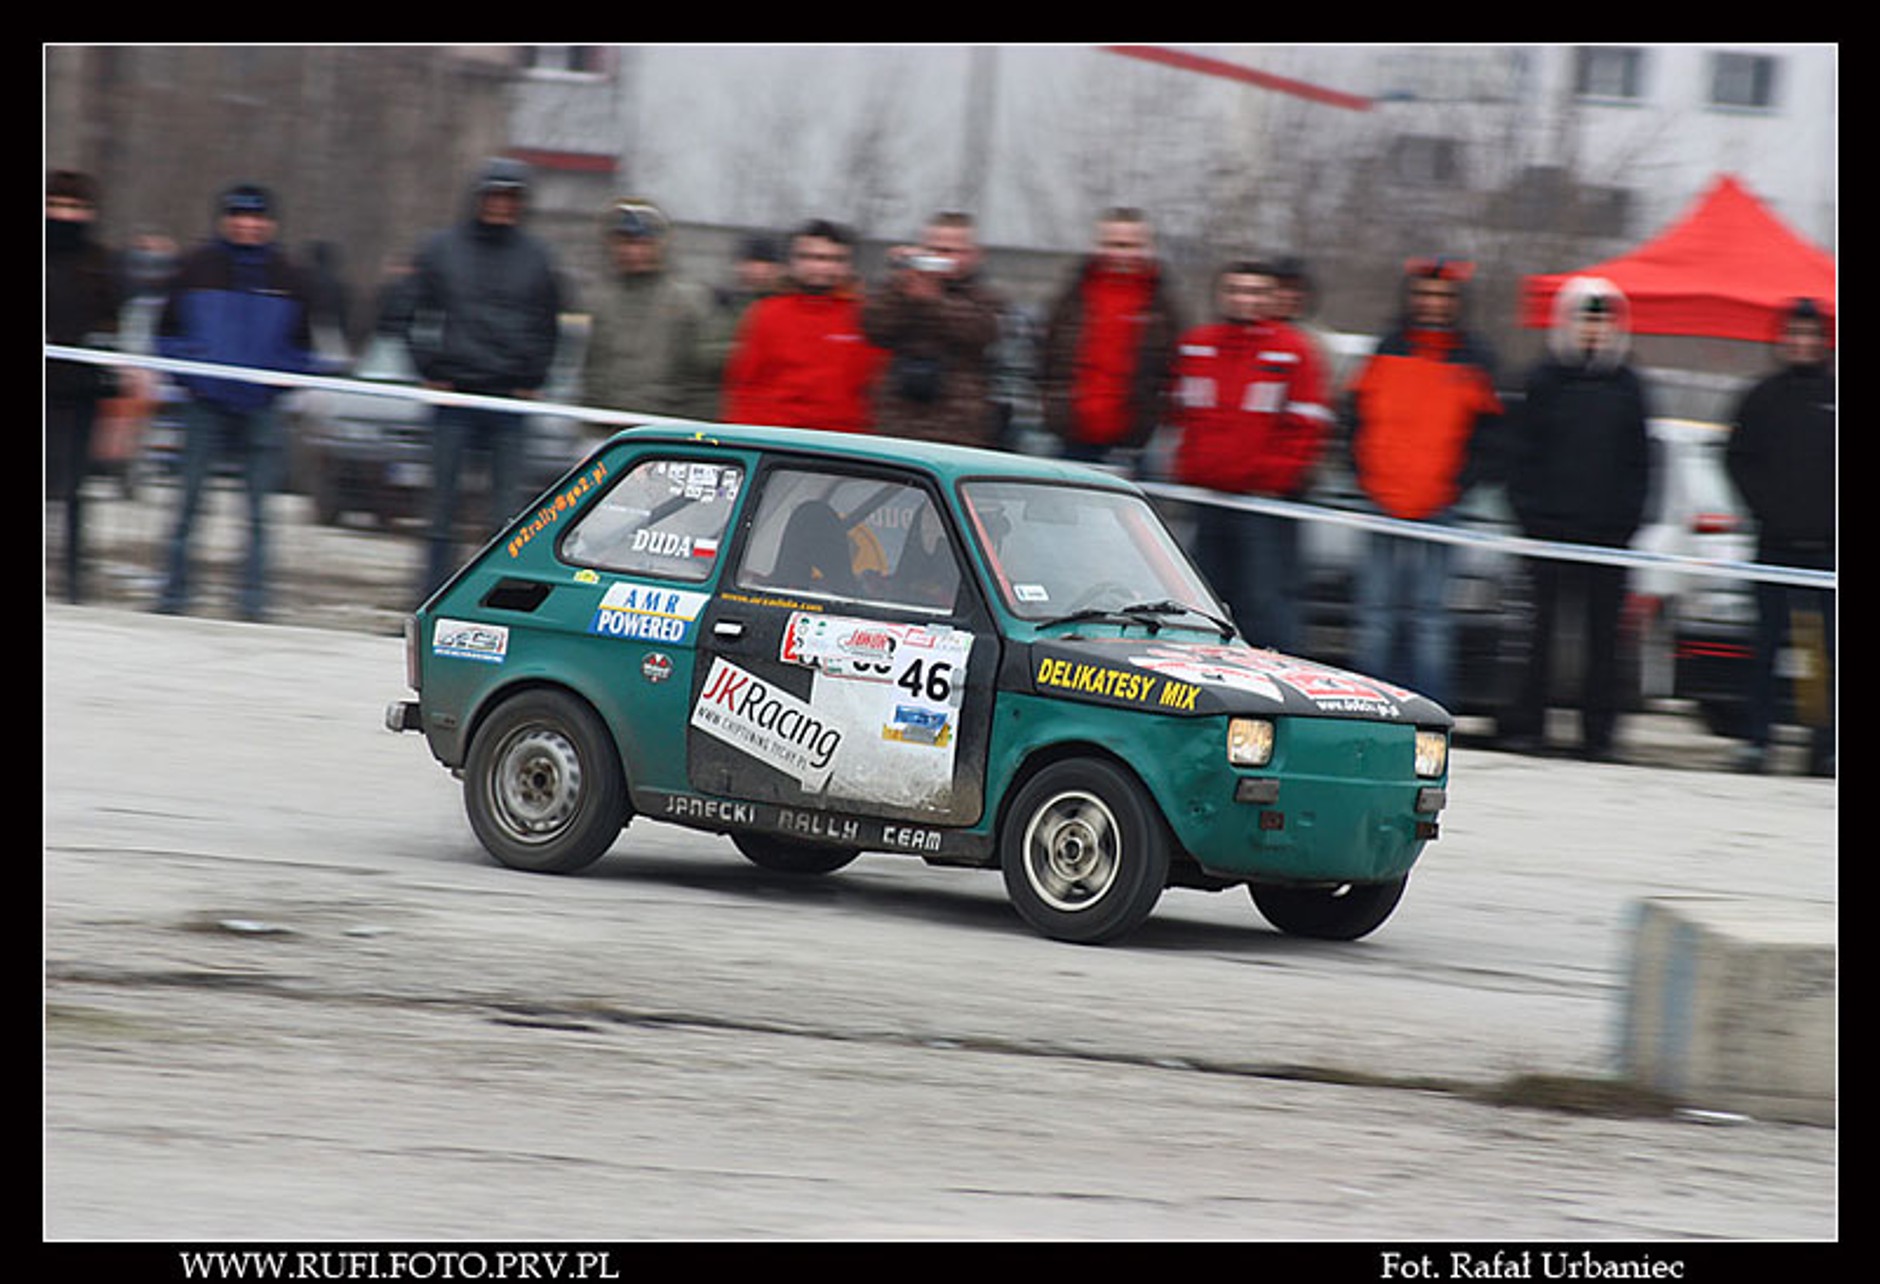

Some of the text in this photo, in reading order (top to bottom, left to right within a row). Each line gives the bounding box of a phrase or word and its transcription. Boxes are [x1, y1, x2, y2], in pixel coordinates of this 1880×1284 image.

[631, 529, 691, 558] DUDA
[598, 610, 685, 641] POWERED
[898, 659, 951, 701] 46
[1037, 658, 1202, 711] DELIKATESY MIX
